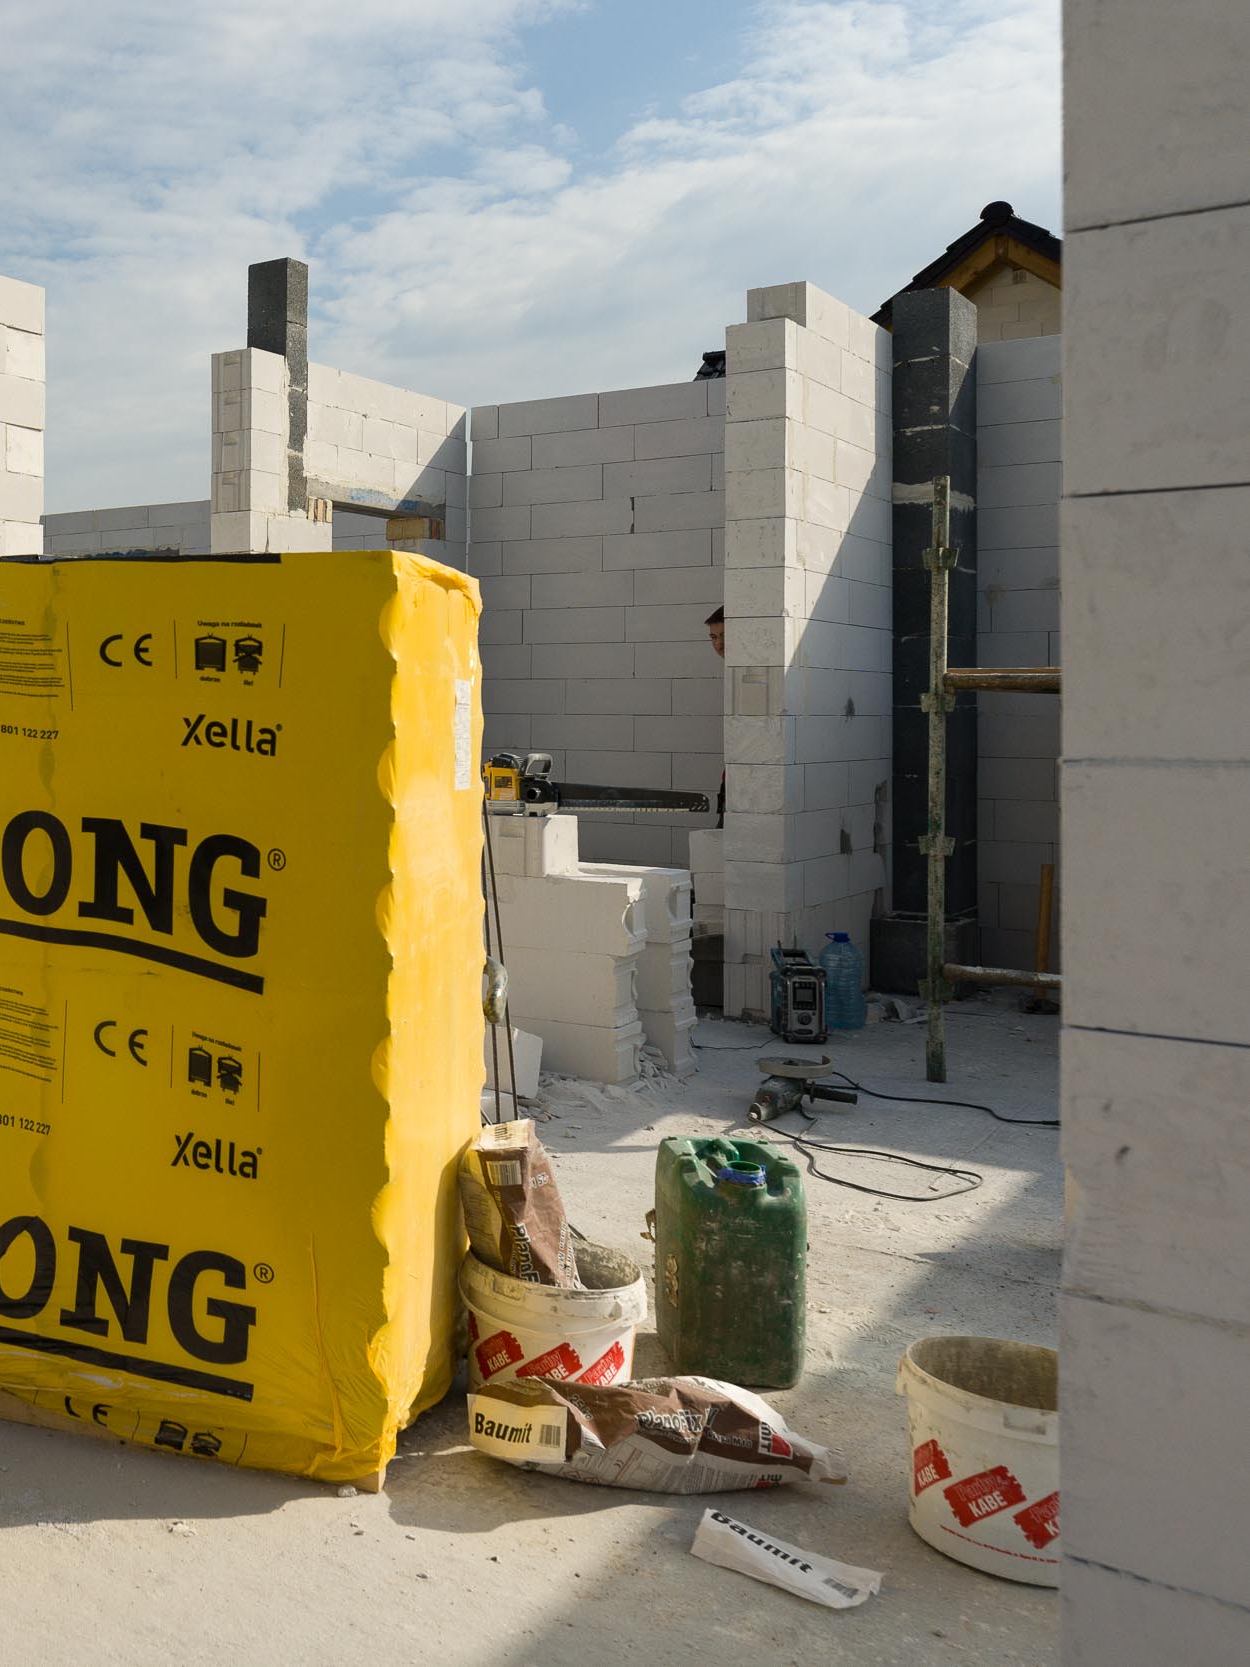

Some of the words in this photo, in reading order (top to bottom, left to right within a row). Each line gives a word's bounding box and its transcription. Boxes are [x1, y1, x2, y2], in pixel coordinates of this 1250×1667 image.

[0, 724, 19, 735] 801
[22, 728, 38, 739] 122
[40, 730, 59, 740] 227
[19, 1118, 34, 1132] 122
[36, 1122, 51, 1136] 227
[486, 1349, 511, 1373] KABE
[475, 1412, 532, 1443] Baumit
[916, 1463, 940, 1487] KABE
[967, 1491, 1007, 1518] KABE
